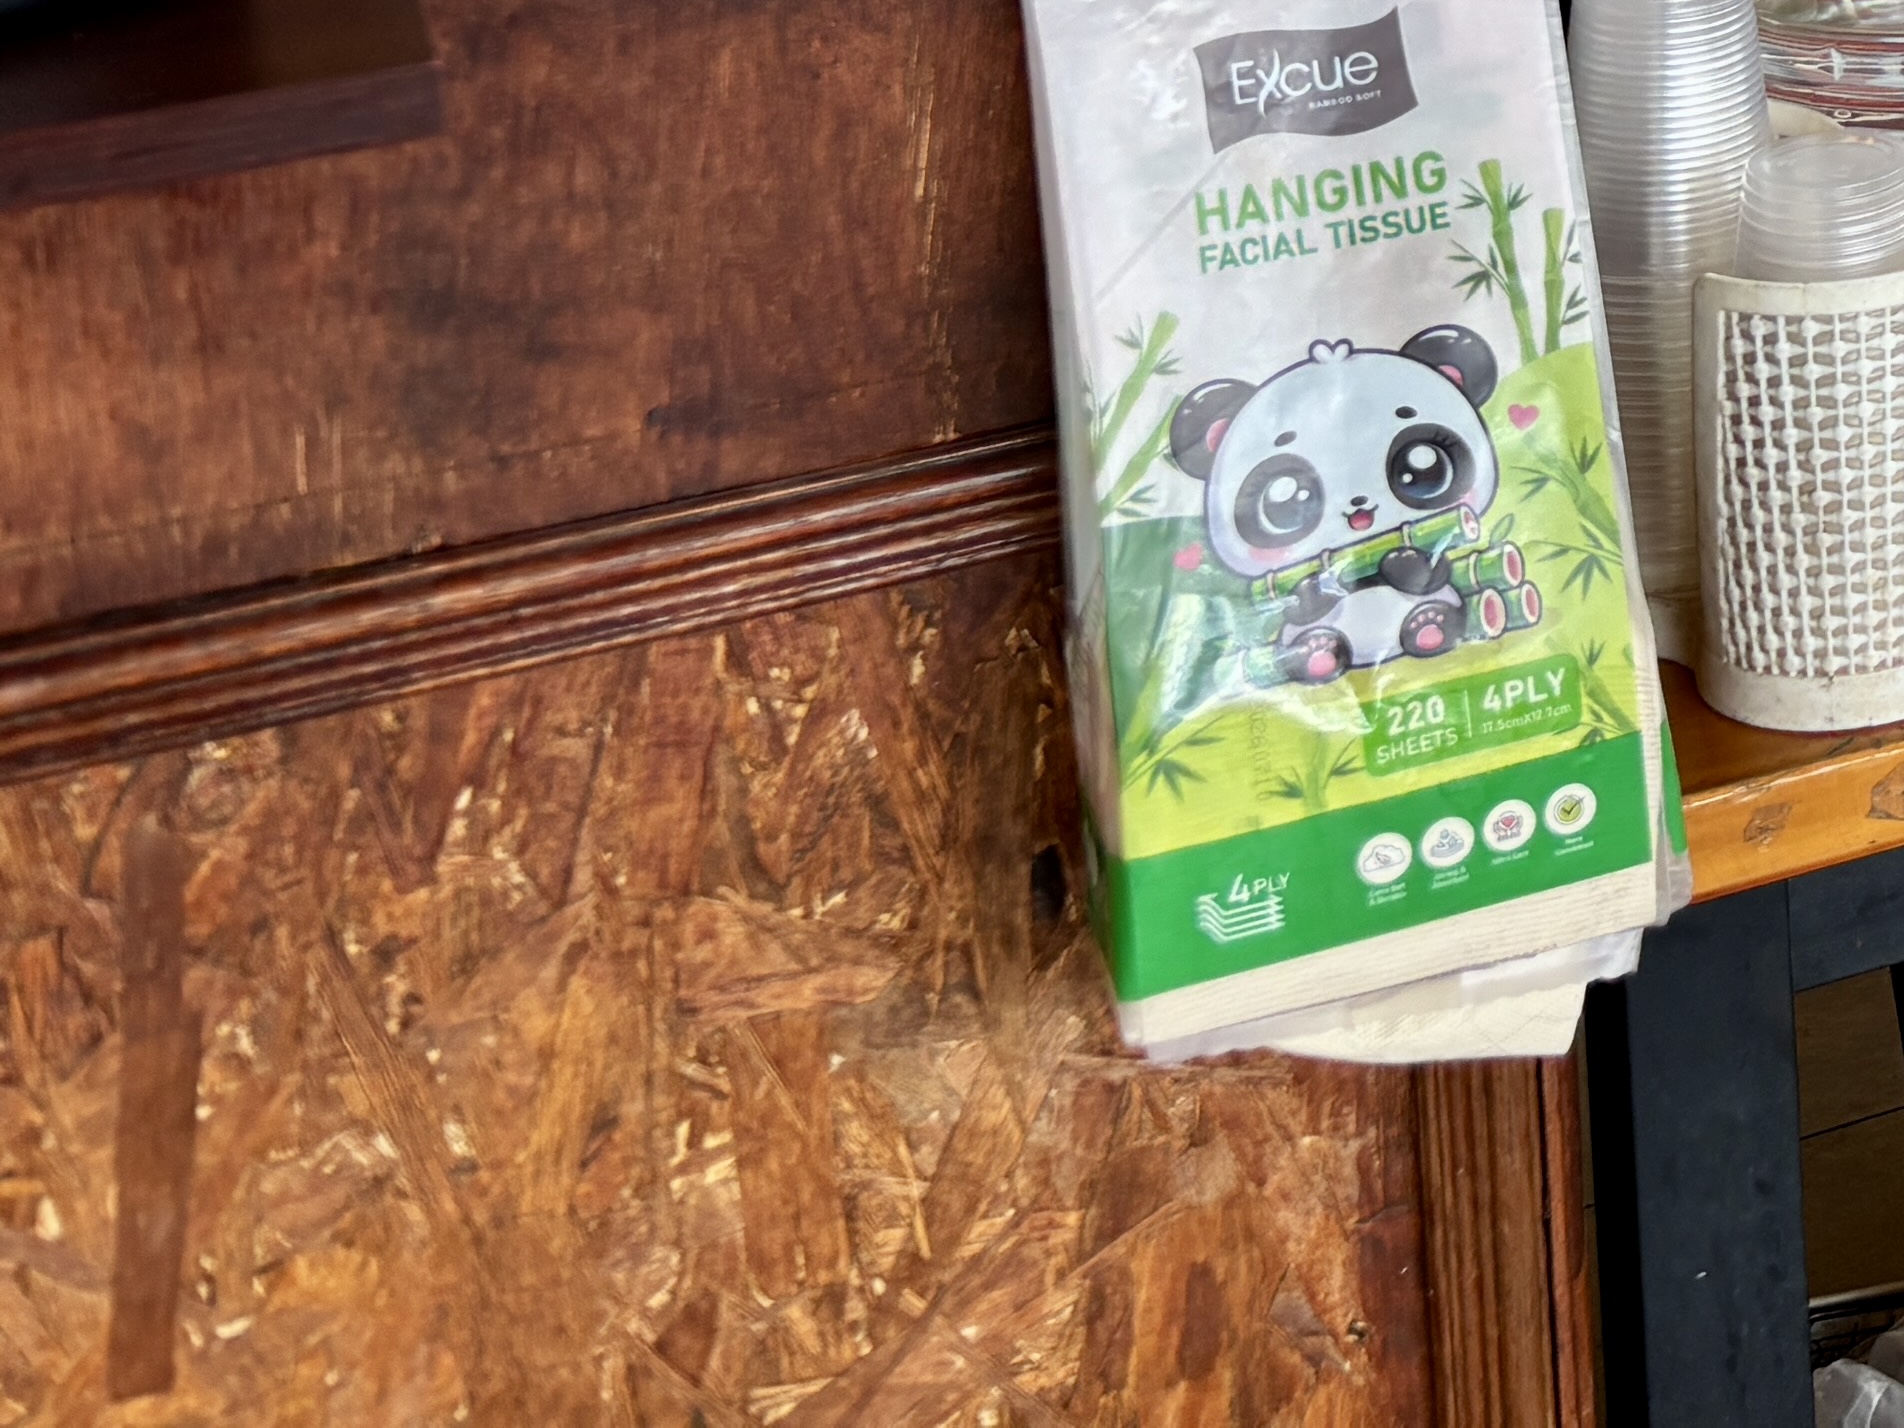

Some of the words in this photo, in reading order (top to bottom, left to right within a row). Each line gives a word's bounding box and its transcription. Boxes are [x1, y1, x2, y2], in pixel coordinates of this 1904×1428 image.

[1231, 49, 1380, 119] Excue
[1195, 151, 1448, 234] HANGING
[1199, 225, 1318, 274] FACIAL
[1324, 201, 1451, 248] TISSUE
[1388, 695, 1445, 736] 220
[1483, 668, 1566, 710] 4PLY
[1376, 728, 1458, 765] SHEETS
